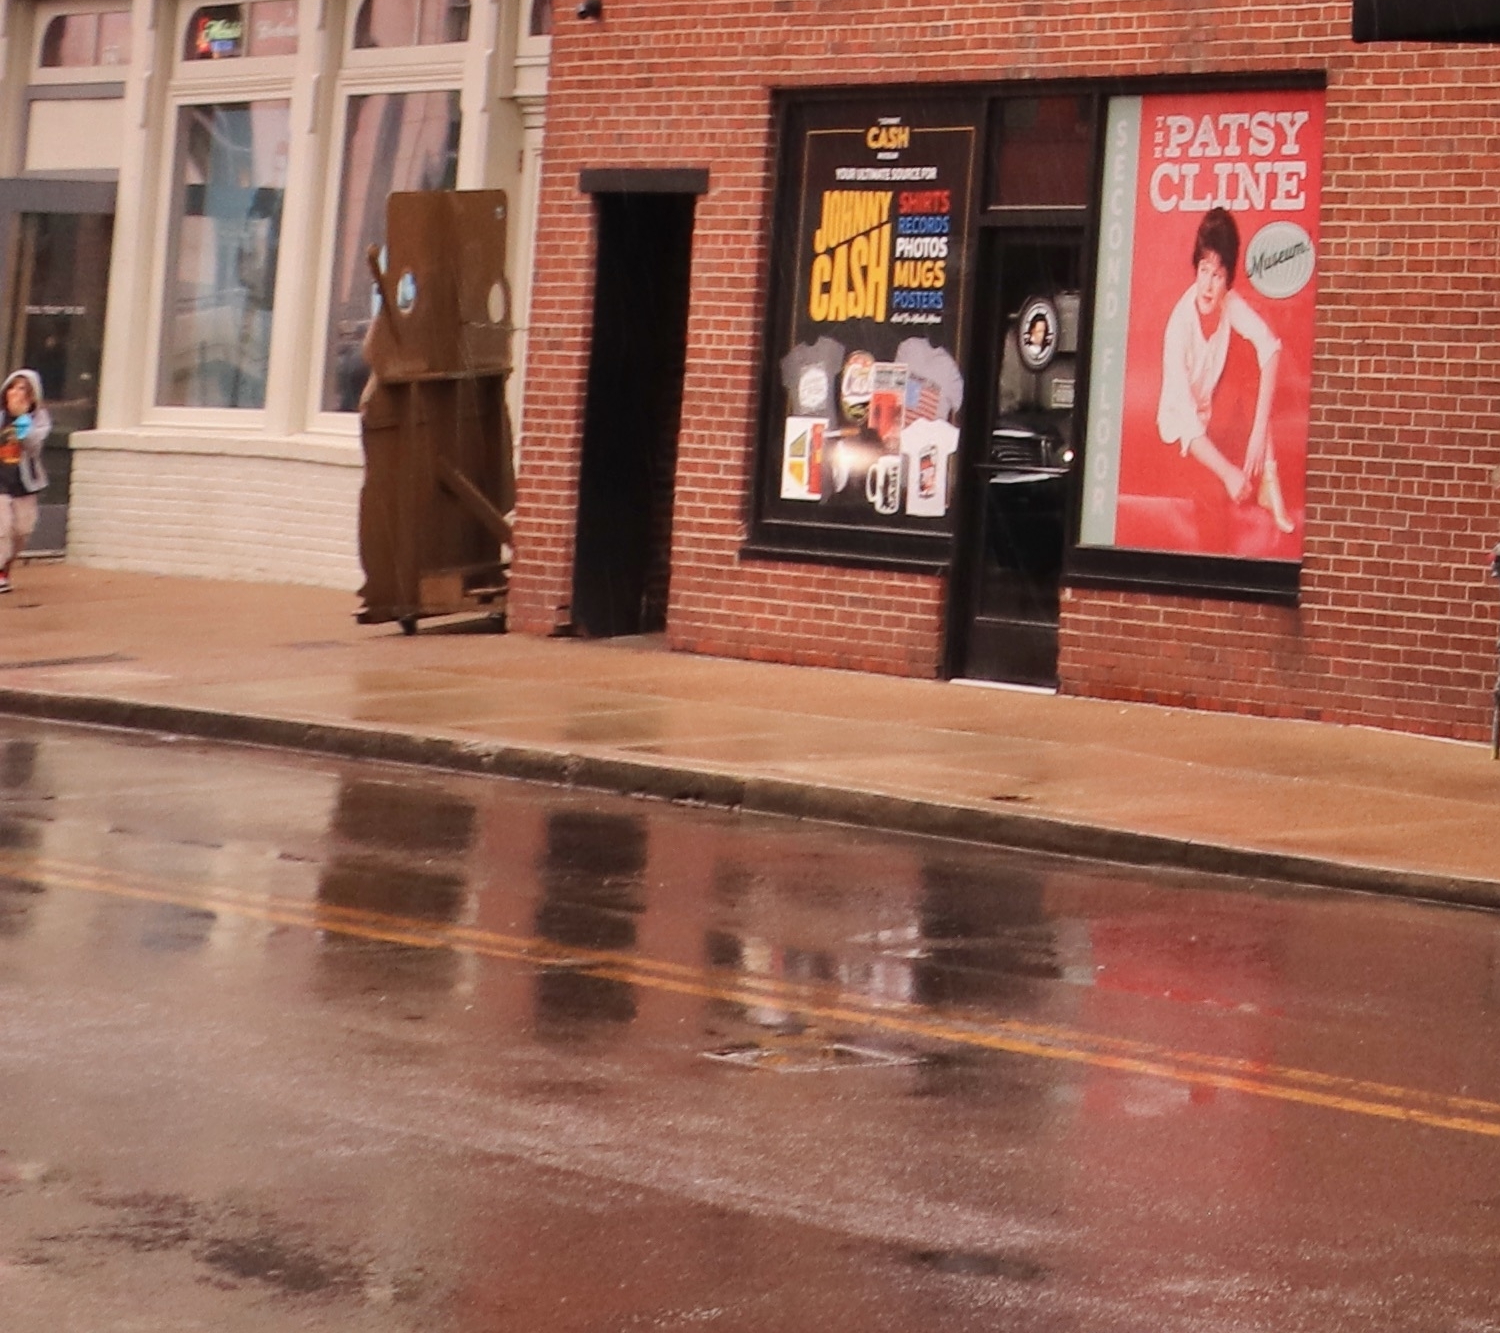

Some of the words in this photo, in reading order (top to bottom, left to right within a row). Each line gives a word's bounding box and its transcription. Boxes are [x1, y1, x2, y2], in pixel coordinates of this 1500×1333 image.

[866, 126, 910, 149] CASH
[1163, 110, 1310, 159] PATSY
[898, 190, 951, 214] SHIRTS
[1149, 160, 1308, 213] CLINE
[814, 189, 894, 254] JOHNNY
[897, 215, 950, 234] RECORDS
[1105, 118, 1129, 321] SECOND
[894, 236, 949, 258] PHOTOS
[1247, 241, 1308, 279] Museum
[808, 221, 893, 323] CASH
[893, 259, 946, 288] MUGS
[892, 290, 944, 309] POSTERS
